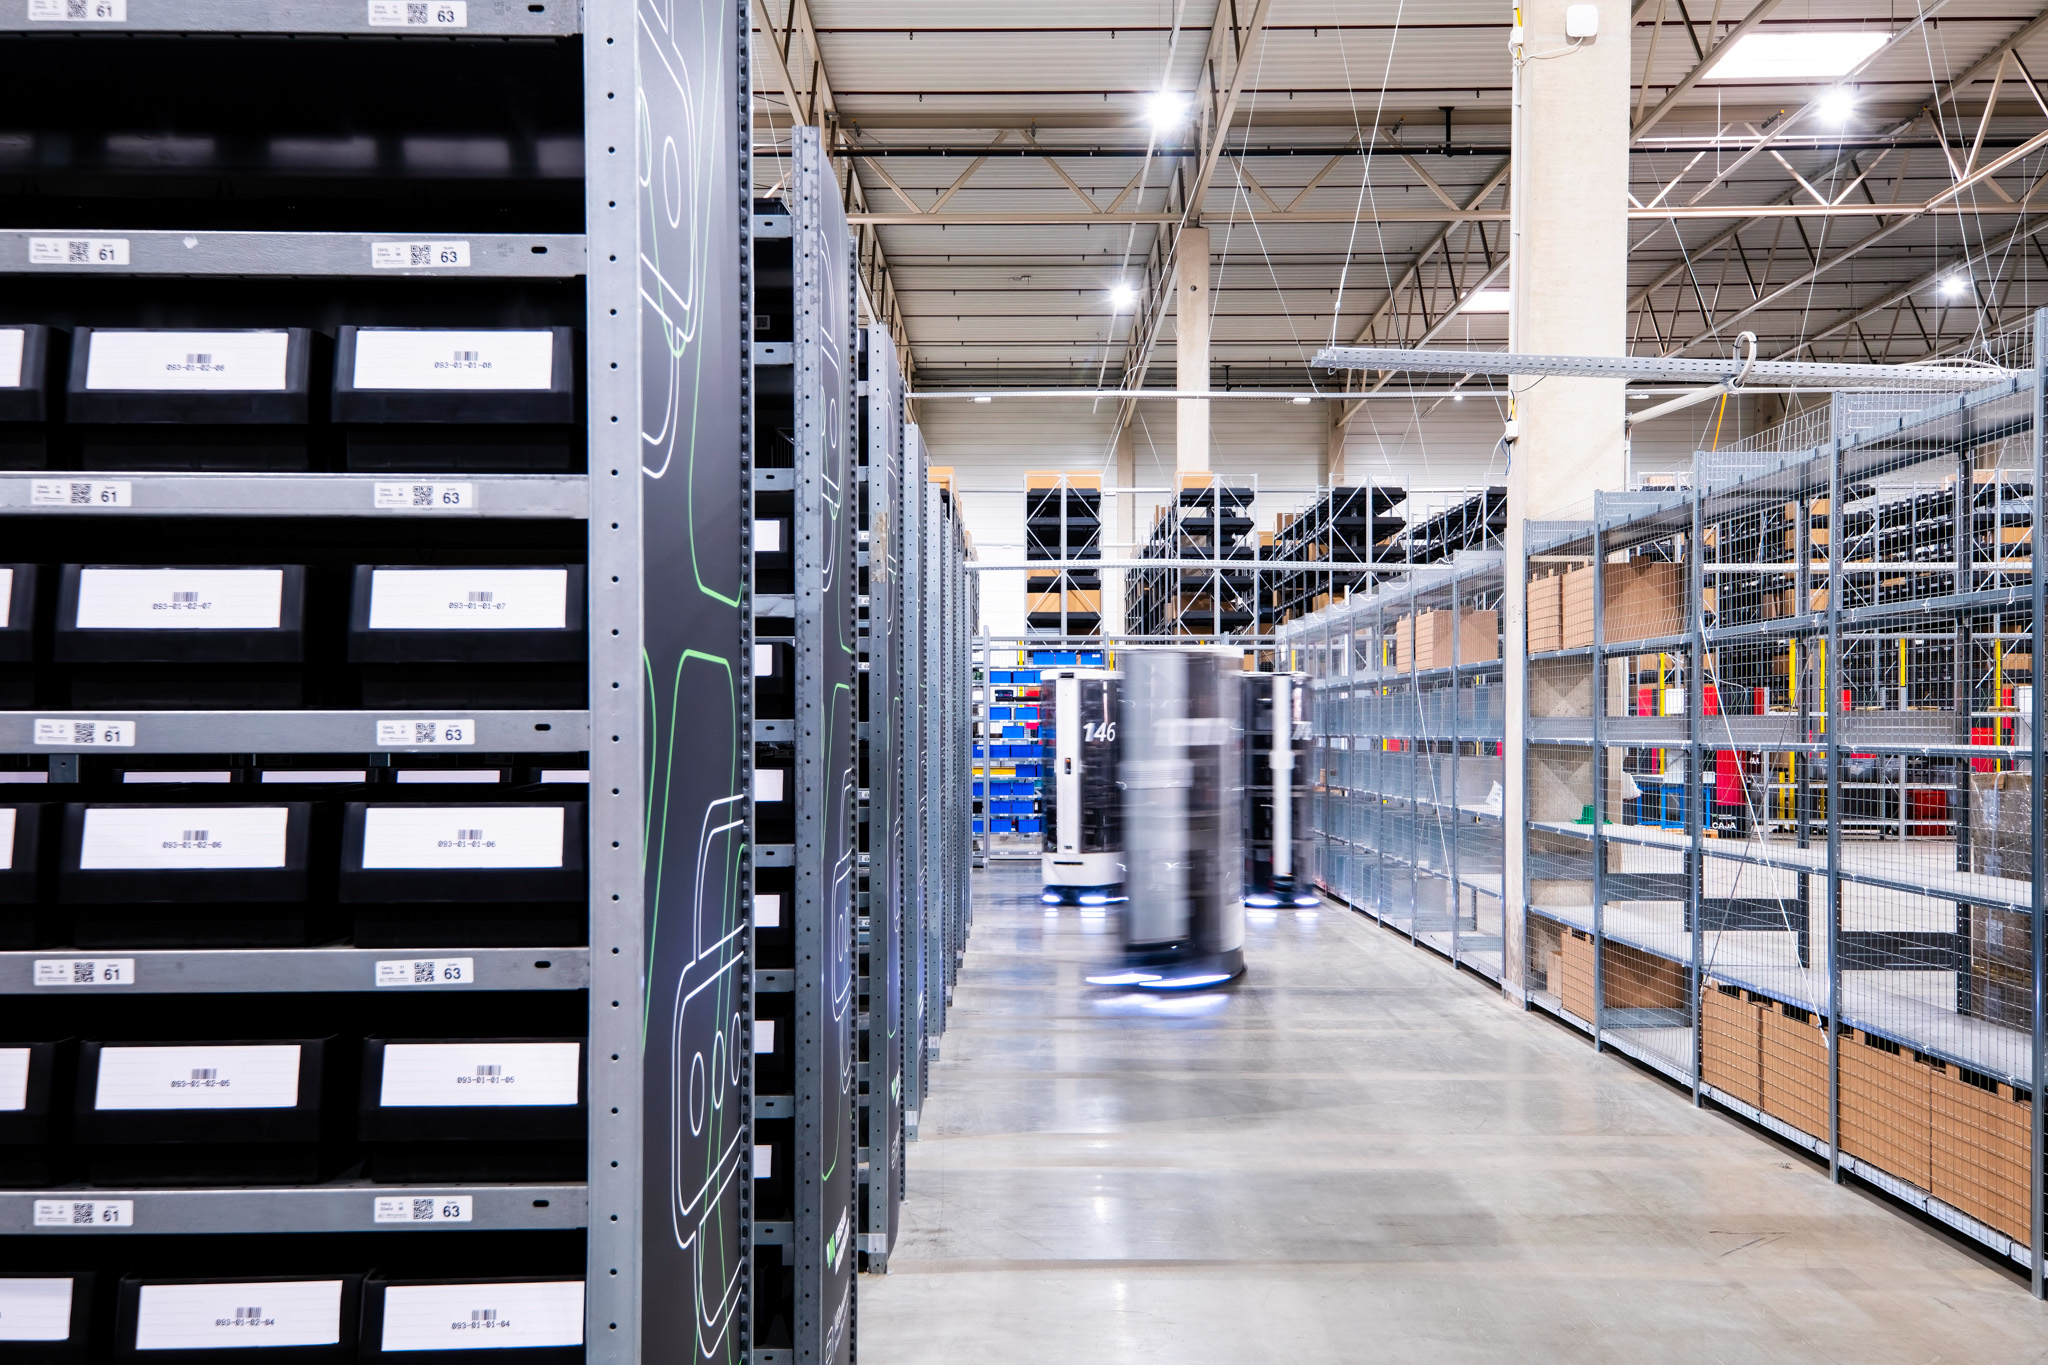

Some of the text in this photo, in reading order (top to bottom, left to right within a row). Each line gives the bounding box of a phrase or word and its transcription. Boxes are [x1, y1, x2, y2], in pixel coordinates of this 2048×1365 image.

[97, 5, 112, 18] 61
[438, 11, 455, 23] 63
[99, 249, 115, 261] 61
[441, 252, 458, 264] 63
[101, 491, 117, 503] 61
[443, 493, 460, 505] 63
[448, 602, 507, 610] 093-01-01-07
[105, 731, 120, 743] 61
[446, 729, 463, 741] 63
[1083, 722, 1116, 742] 146
[437, 840, 497, 848] 093-01-01-06
[104, 969, 120, 981] 61
[444, 968, 461, 980] 63
[456, 1076, 515, 1084] 093-01-01-05
[103, 1209, 118, 1222] 61
[443, 1206, 460, 1218] 63
[451, 1320, 511, 1330] 093-01-01-04
